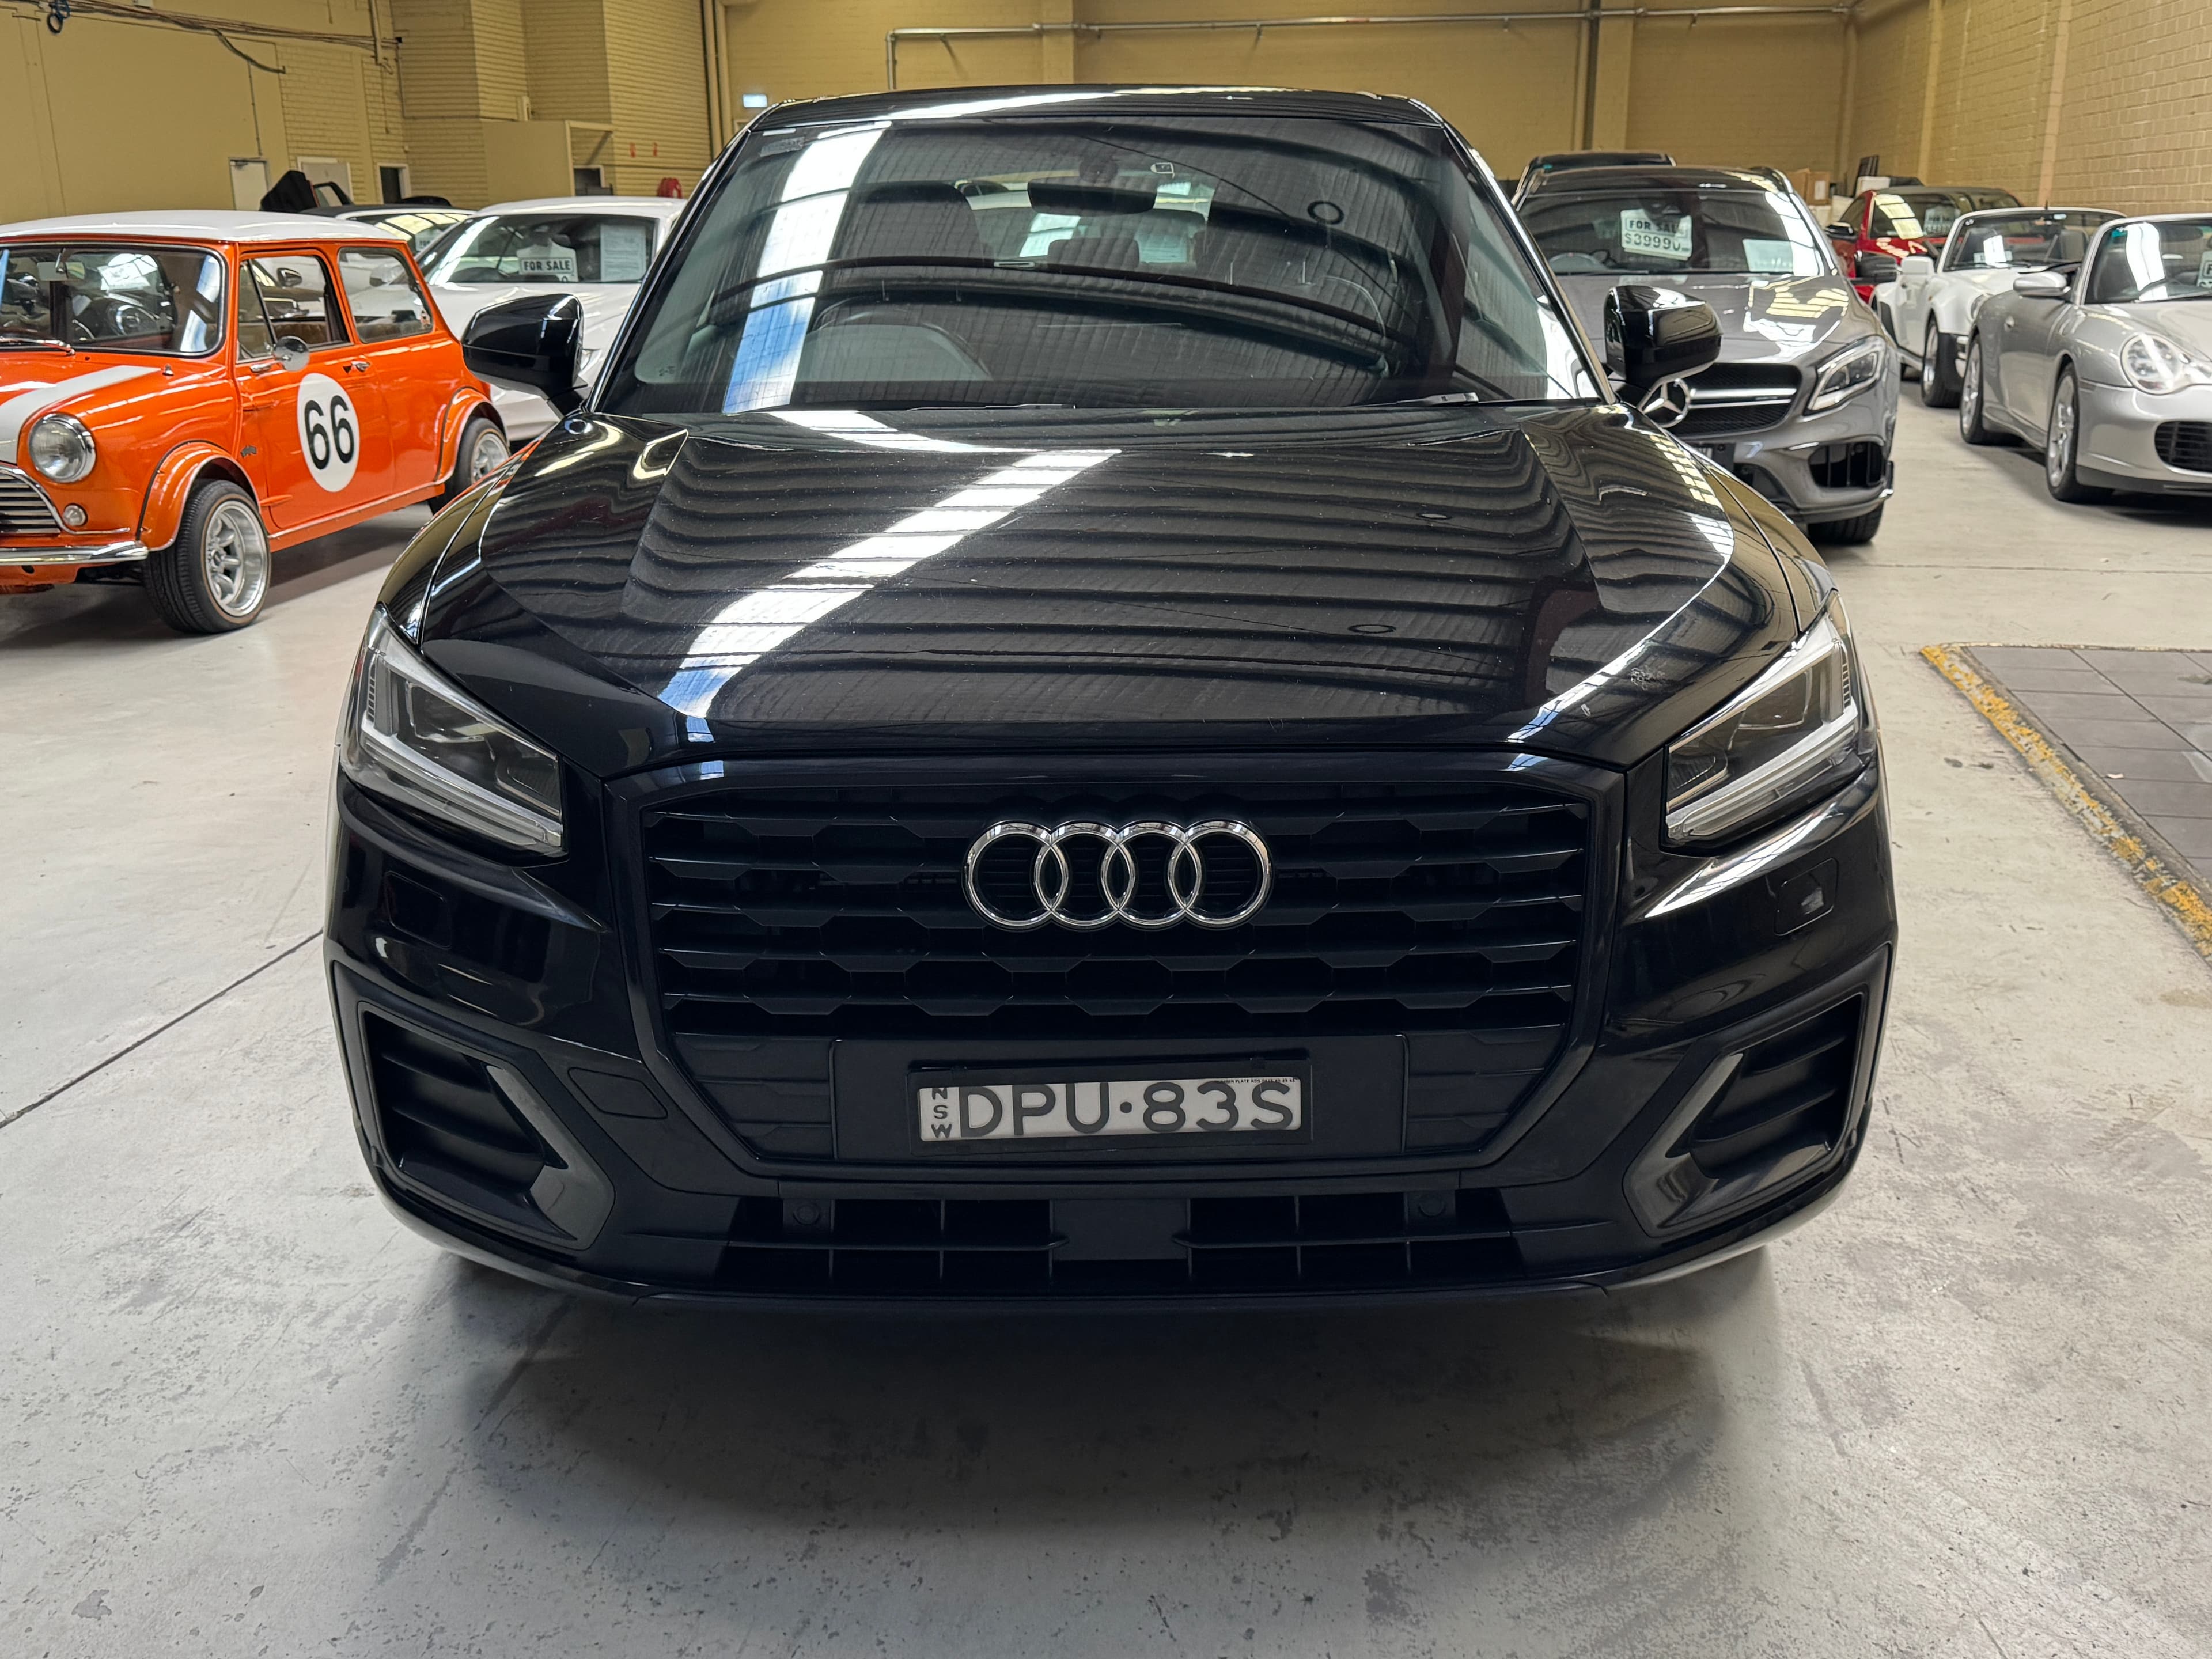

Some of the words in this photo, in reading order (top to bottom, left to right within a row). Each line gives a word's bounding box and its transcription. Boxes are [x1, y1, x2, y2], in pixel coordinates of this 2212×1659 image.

[1629, 220, 1651, 230] FOR
[524, 260, 542, 271] FOR
[546, 260, 571, 271] SALE
[304, 395, 354, 470] 66
